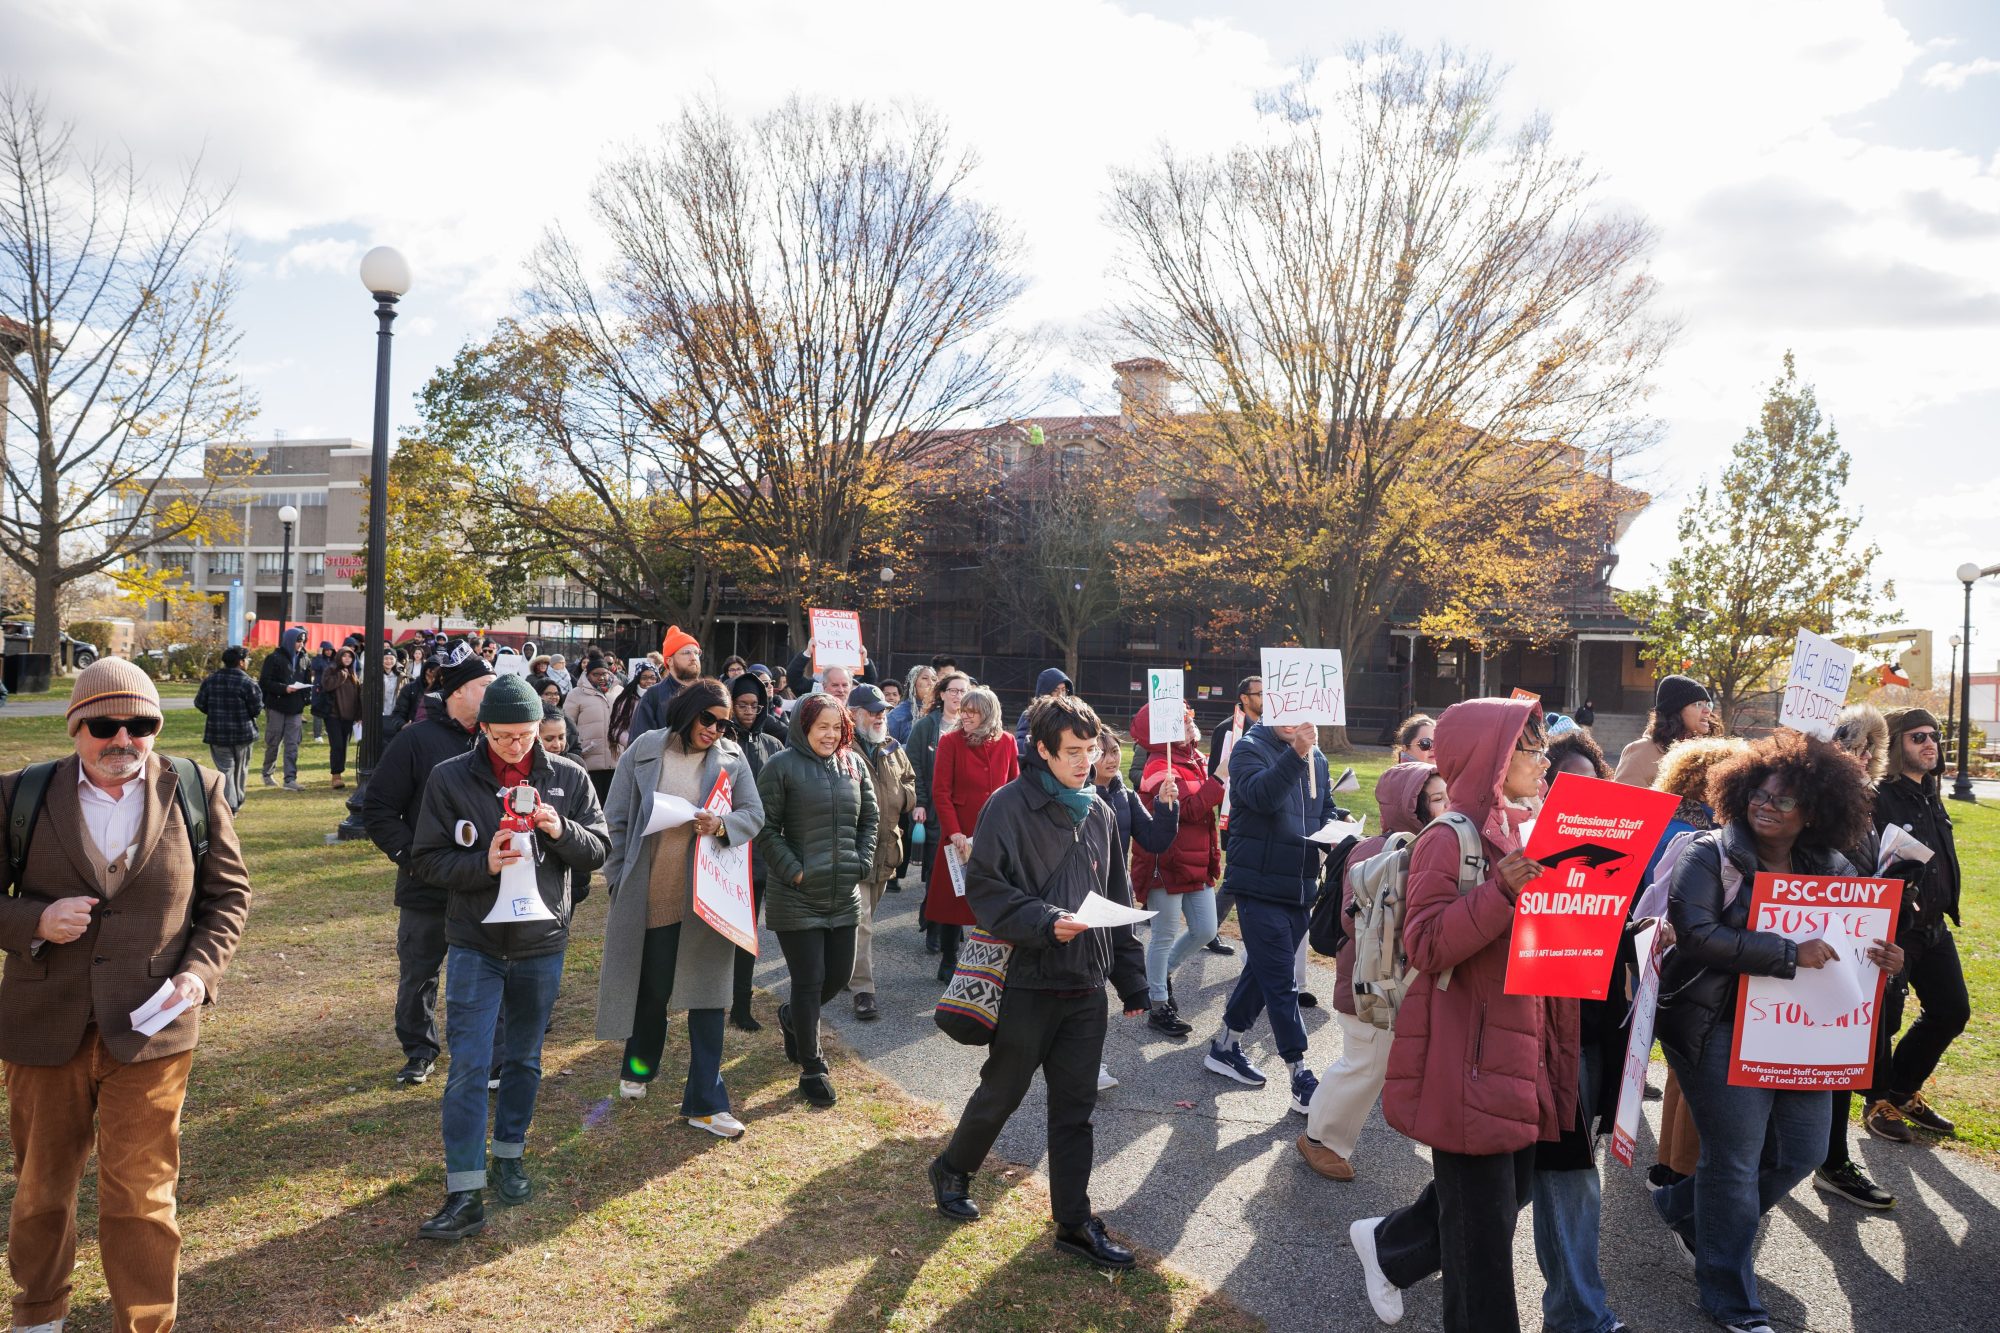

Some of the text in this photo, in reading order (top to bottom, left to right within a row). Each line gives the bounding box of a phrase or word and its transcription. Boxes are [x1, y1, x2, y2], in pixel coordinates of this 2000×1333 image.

[325, 556, 364, 567] STUDEN
[814, 610, 853, 619] PSC-CUNY
[815, 619, 855, 630] JUSTICE
[818, 640, 855, 651] SEEK
[1267, 660, 1338, 691] HELP
[1793, 641, 1848, 693] WE NEED
[1266, 688, 1341, 722] DELANY
[1785, 685, 1845, 727] JUSTICE
[1557, 813, 1644, 830] Professional Staff
[1558, 825, 1634, 840] Congress/CUNY
[700, 853, 750, 908] WORKERS
[1567, 868, 1586, 888] In
[1772, 879, 1888, 903] PSC-CUNY
[1520, 892, 1627, 916] SOLIDARITY
[1762, 907, 1871, 938] JUSTCE
[1550, 949, 1564, 957] Local
[1582, 949, 1604, 957] AFL-CIO
[1741, 1064, 1865, 1078] Professional Staff Congress/CUNY
[1759, 1075, 1774, 1083] AFT
[1776, 1075, 1796, 1085] Local
[1797, 1077, 1817, 1085] 2334
[1823, 1076, 1851, 1085] AFL-CIO
